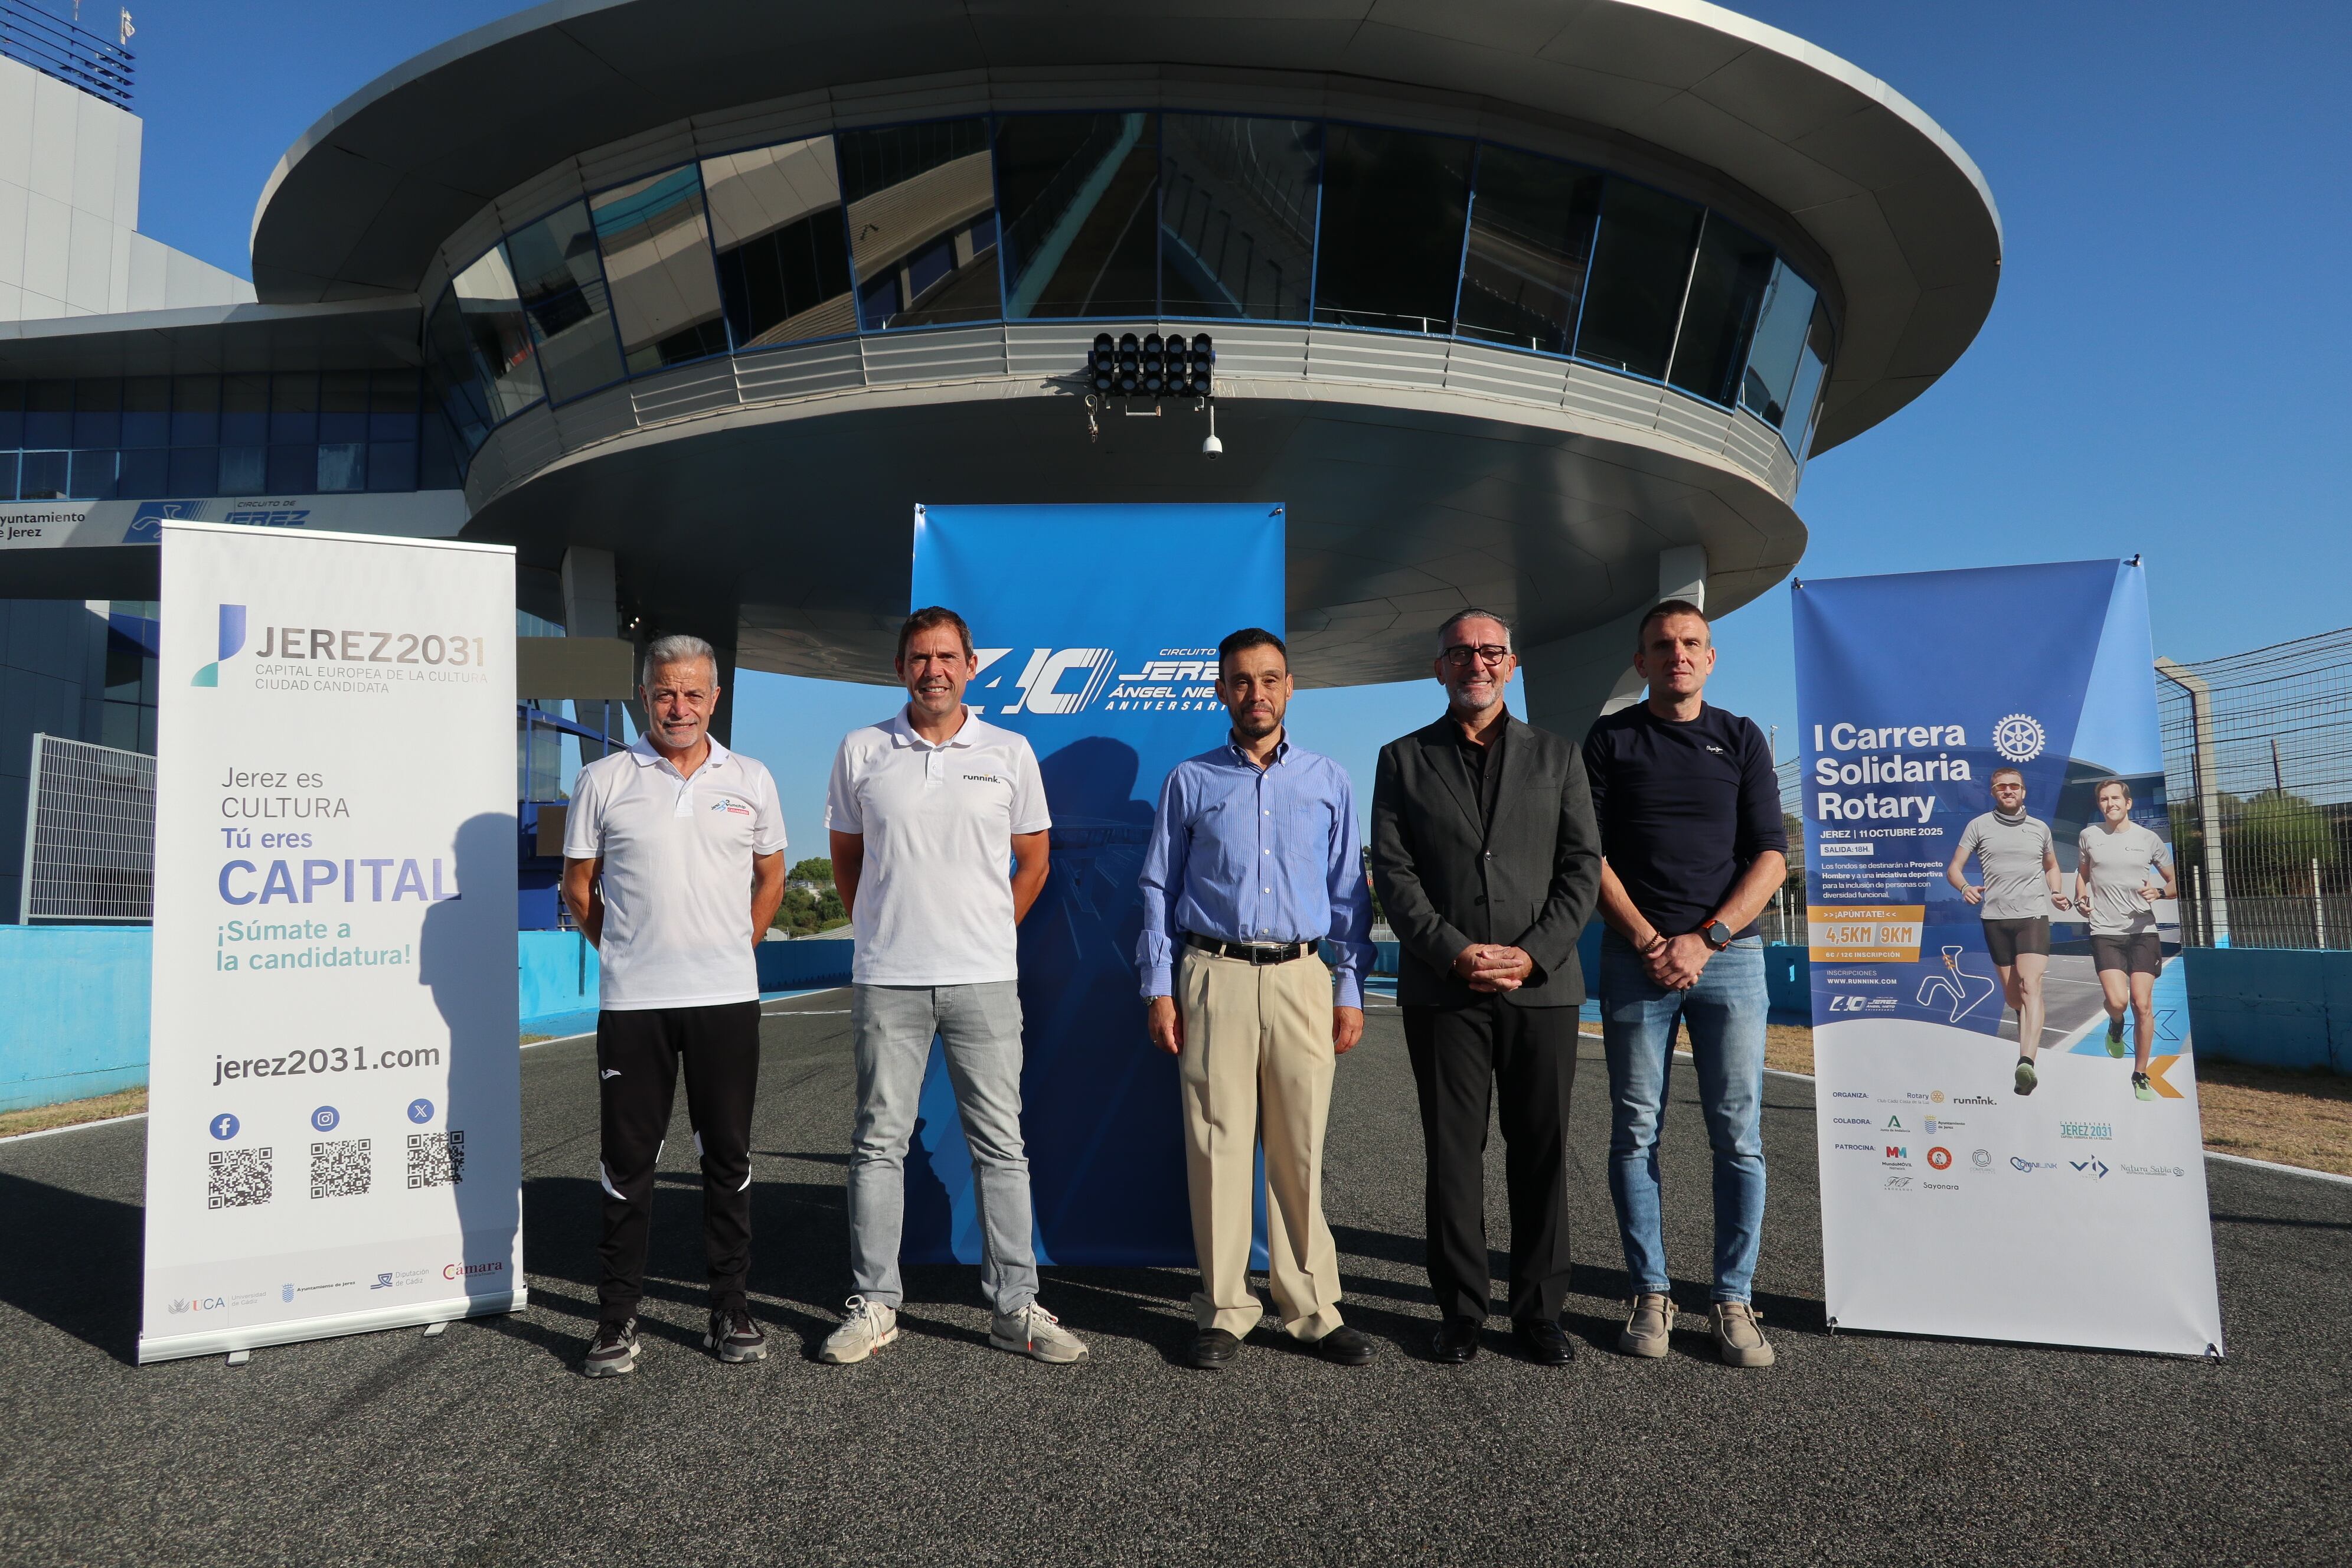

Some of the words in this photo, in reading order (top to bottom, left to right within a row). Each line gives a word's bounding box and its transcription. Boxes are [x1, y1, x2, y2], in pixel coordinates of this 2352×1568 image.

[0, 512, 86, 527] yuntamiento
[7, 527, 42, 540] Jerez
[255, 626, 484, 667] JEREZ2031
[255, 664, 312, 677] CAPITAL
[317, 666, 382, 679] EUROPEA
[387, 669, 404, 680] DE
[409, 670, 424, 681] LA
[429, 671, 488, 684] CULTURA
[1118, 661, 1220, 681] JERE
[255, 678, 309, 691] CIUDAD
[314, 680, 390, 694] CANDIDATA
[1108, 683, 1177, 698] ÁNGEL
[1181, 687, 1216, 698] NIE
[1105, 701, 1227, 711] ANIVERSARI
[1814, 724, 1824, 752] I
[1830, 722, 1966, 751] Carrera
[221, 767, 288, 788] Jerez
[296, 772, 324, 788] es
[963, 774, 1001, 783] runnink.
[1815, 753, 1972, 786] Solidaria
[221, 797, 351, 818] CULTURA
[1818, 792, 1936, 824] Rotary
[220, 827, 251, 848] Tú
[261, 832, 313, 848] eres
[1820, 830, 1851, 839] JEREZ
[1868, 828, 1917, 838] OCTUBRE
[1918, 828, 1943, 836] 2025
[218, 858, 462, 905] CAPITAL
[1909, 871, 1943, 879] deportiva
[218, 919, 328, 946] ¡Súmate
[337, 922, 351, 938] a
[1825, 926, 1871, 945] 4,5KM
[1880, 926, 1913, 943] 9KM
[217, 950, 239, 972] la
[249, 944, 411, 970] candidatura!
[213, 1046, 440, 1086] jerez2031.com
[1954, 1096, 1997, 1105] runnink.
[2060, 1125, 2089, 1136] JEREZ
[2090, 1126, 2112, 1136] 2031
[1923, 1182, 1959, 1190] Sayonara
[396, 1269, 429, 1279] Diputación
[443, 1262, 503, 1280] Cámara
[192, 1297, 226, 1311] UCA
[231, 1291, 267, 1301] Universidad
